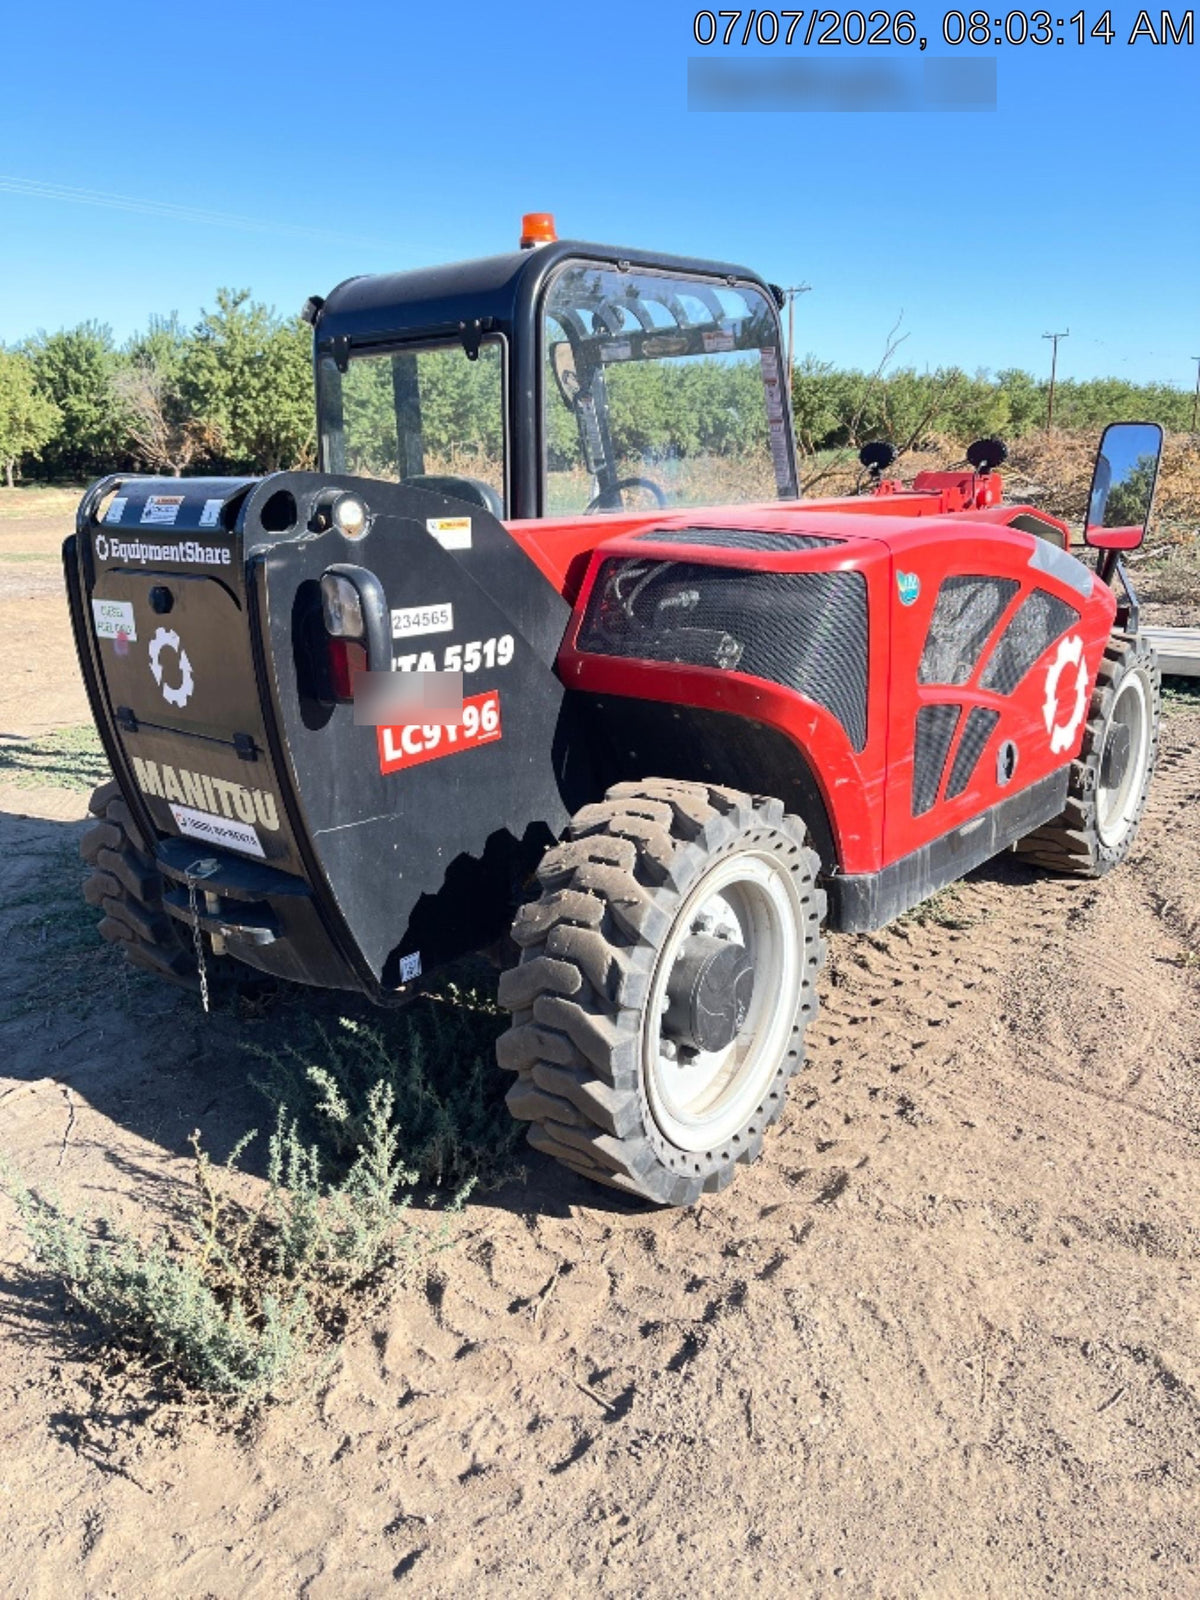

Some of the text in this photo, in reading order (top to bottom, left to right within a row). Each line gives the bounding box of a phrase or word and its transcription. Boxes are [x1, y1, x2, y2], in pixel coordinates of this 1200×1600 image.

[109, 538, 232, 565] EquipmentShare
[393, 609, 449, 630] 234565
[443, 634, 515, 673] 5519
[132, 756, 280, 832] MANITOU
